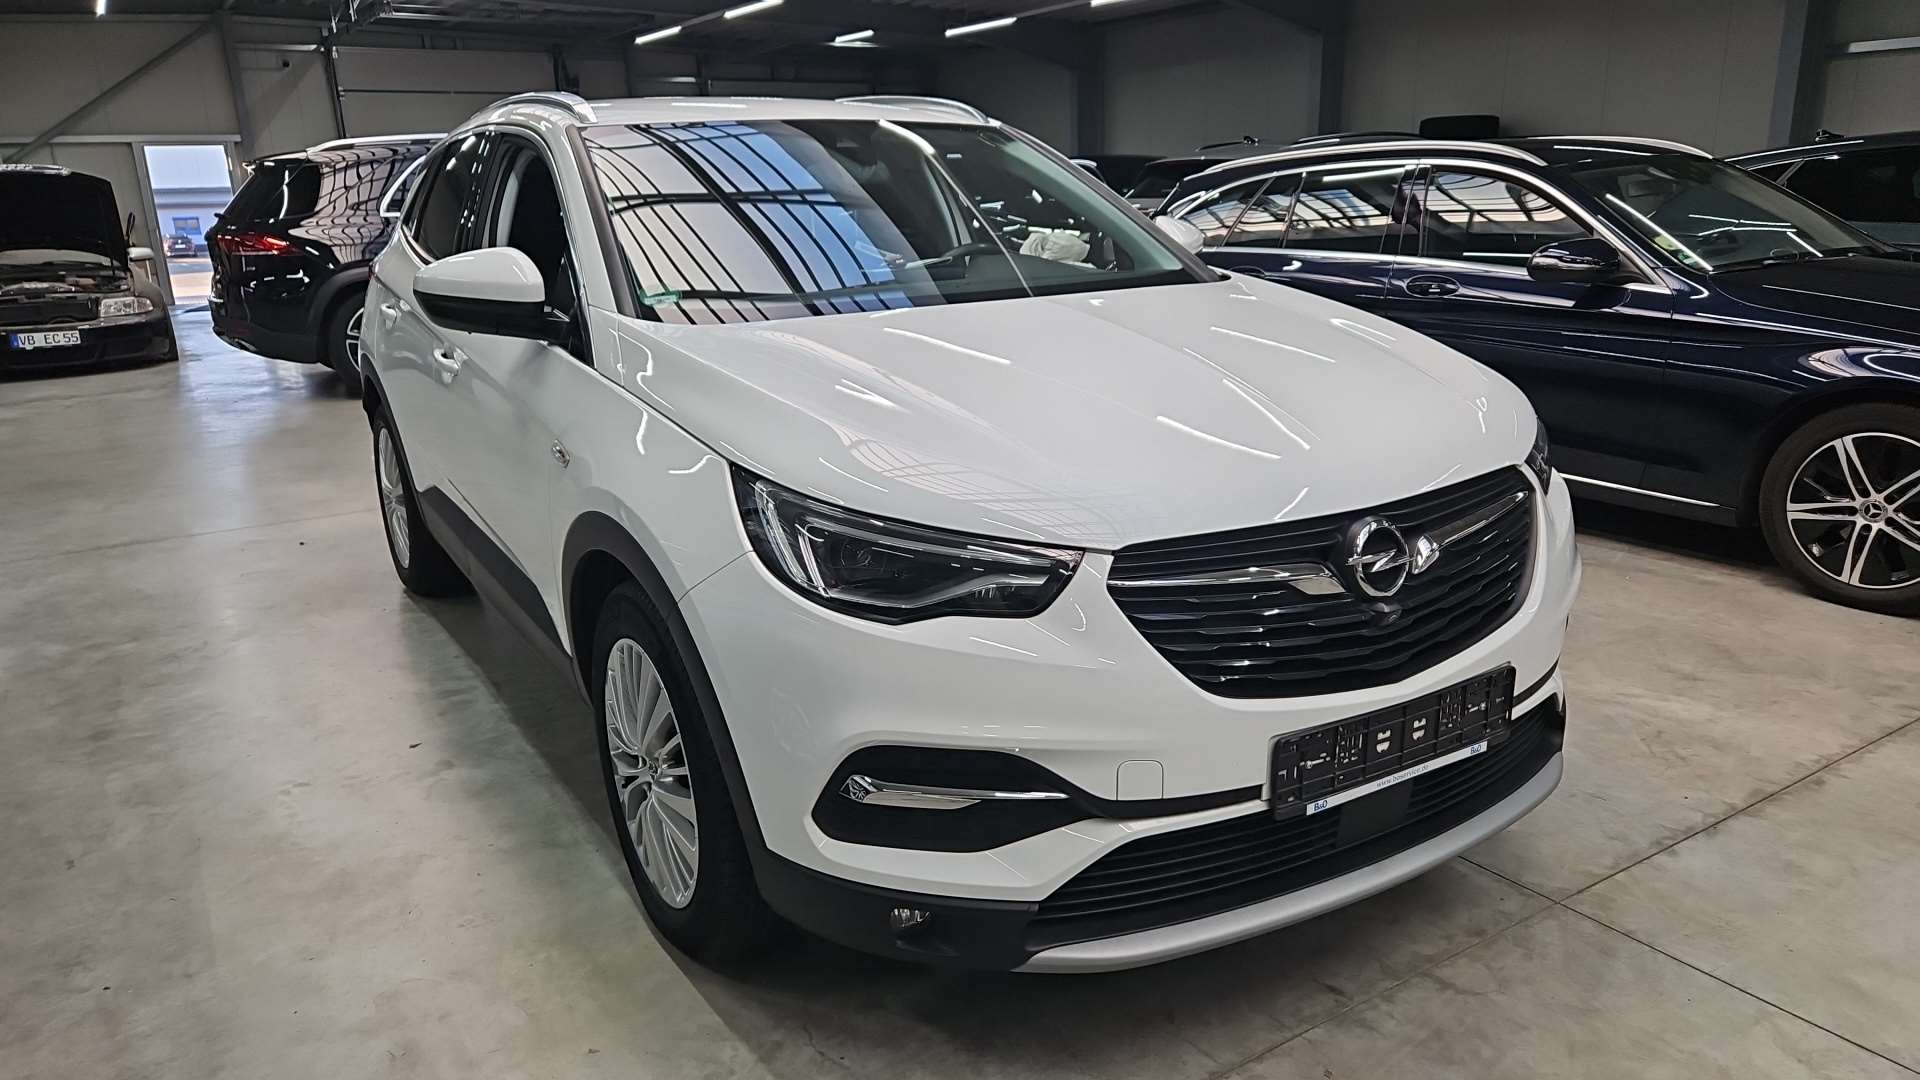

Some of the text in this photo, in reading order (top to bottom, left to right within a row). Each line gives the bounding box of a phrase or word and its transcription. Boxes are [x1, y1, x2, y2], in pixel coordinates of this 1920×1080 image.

[18, 332, 79, 346] VB EC 55
